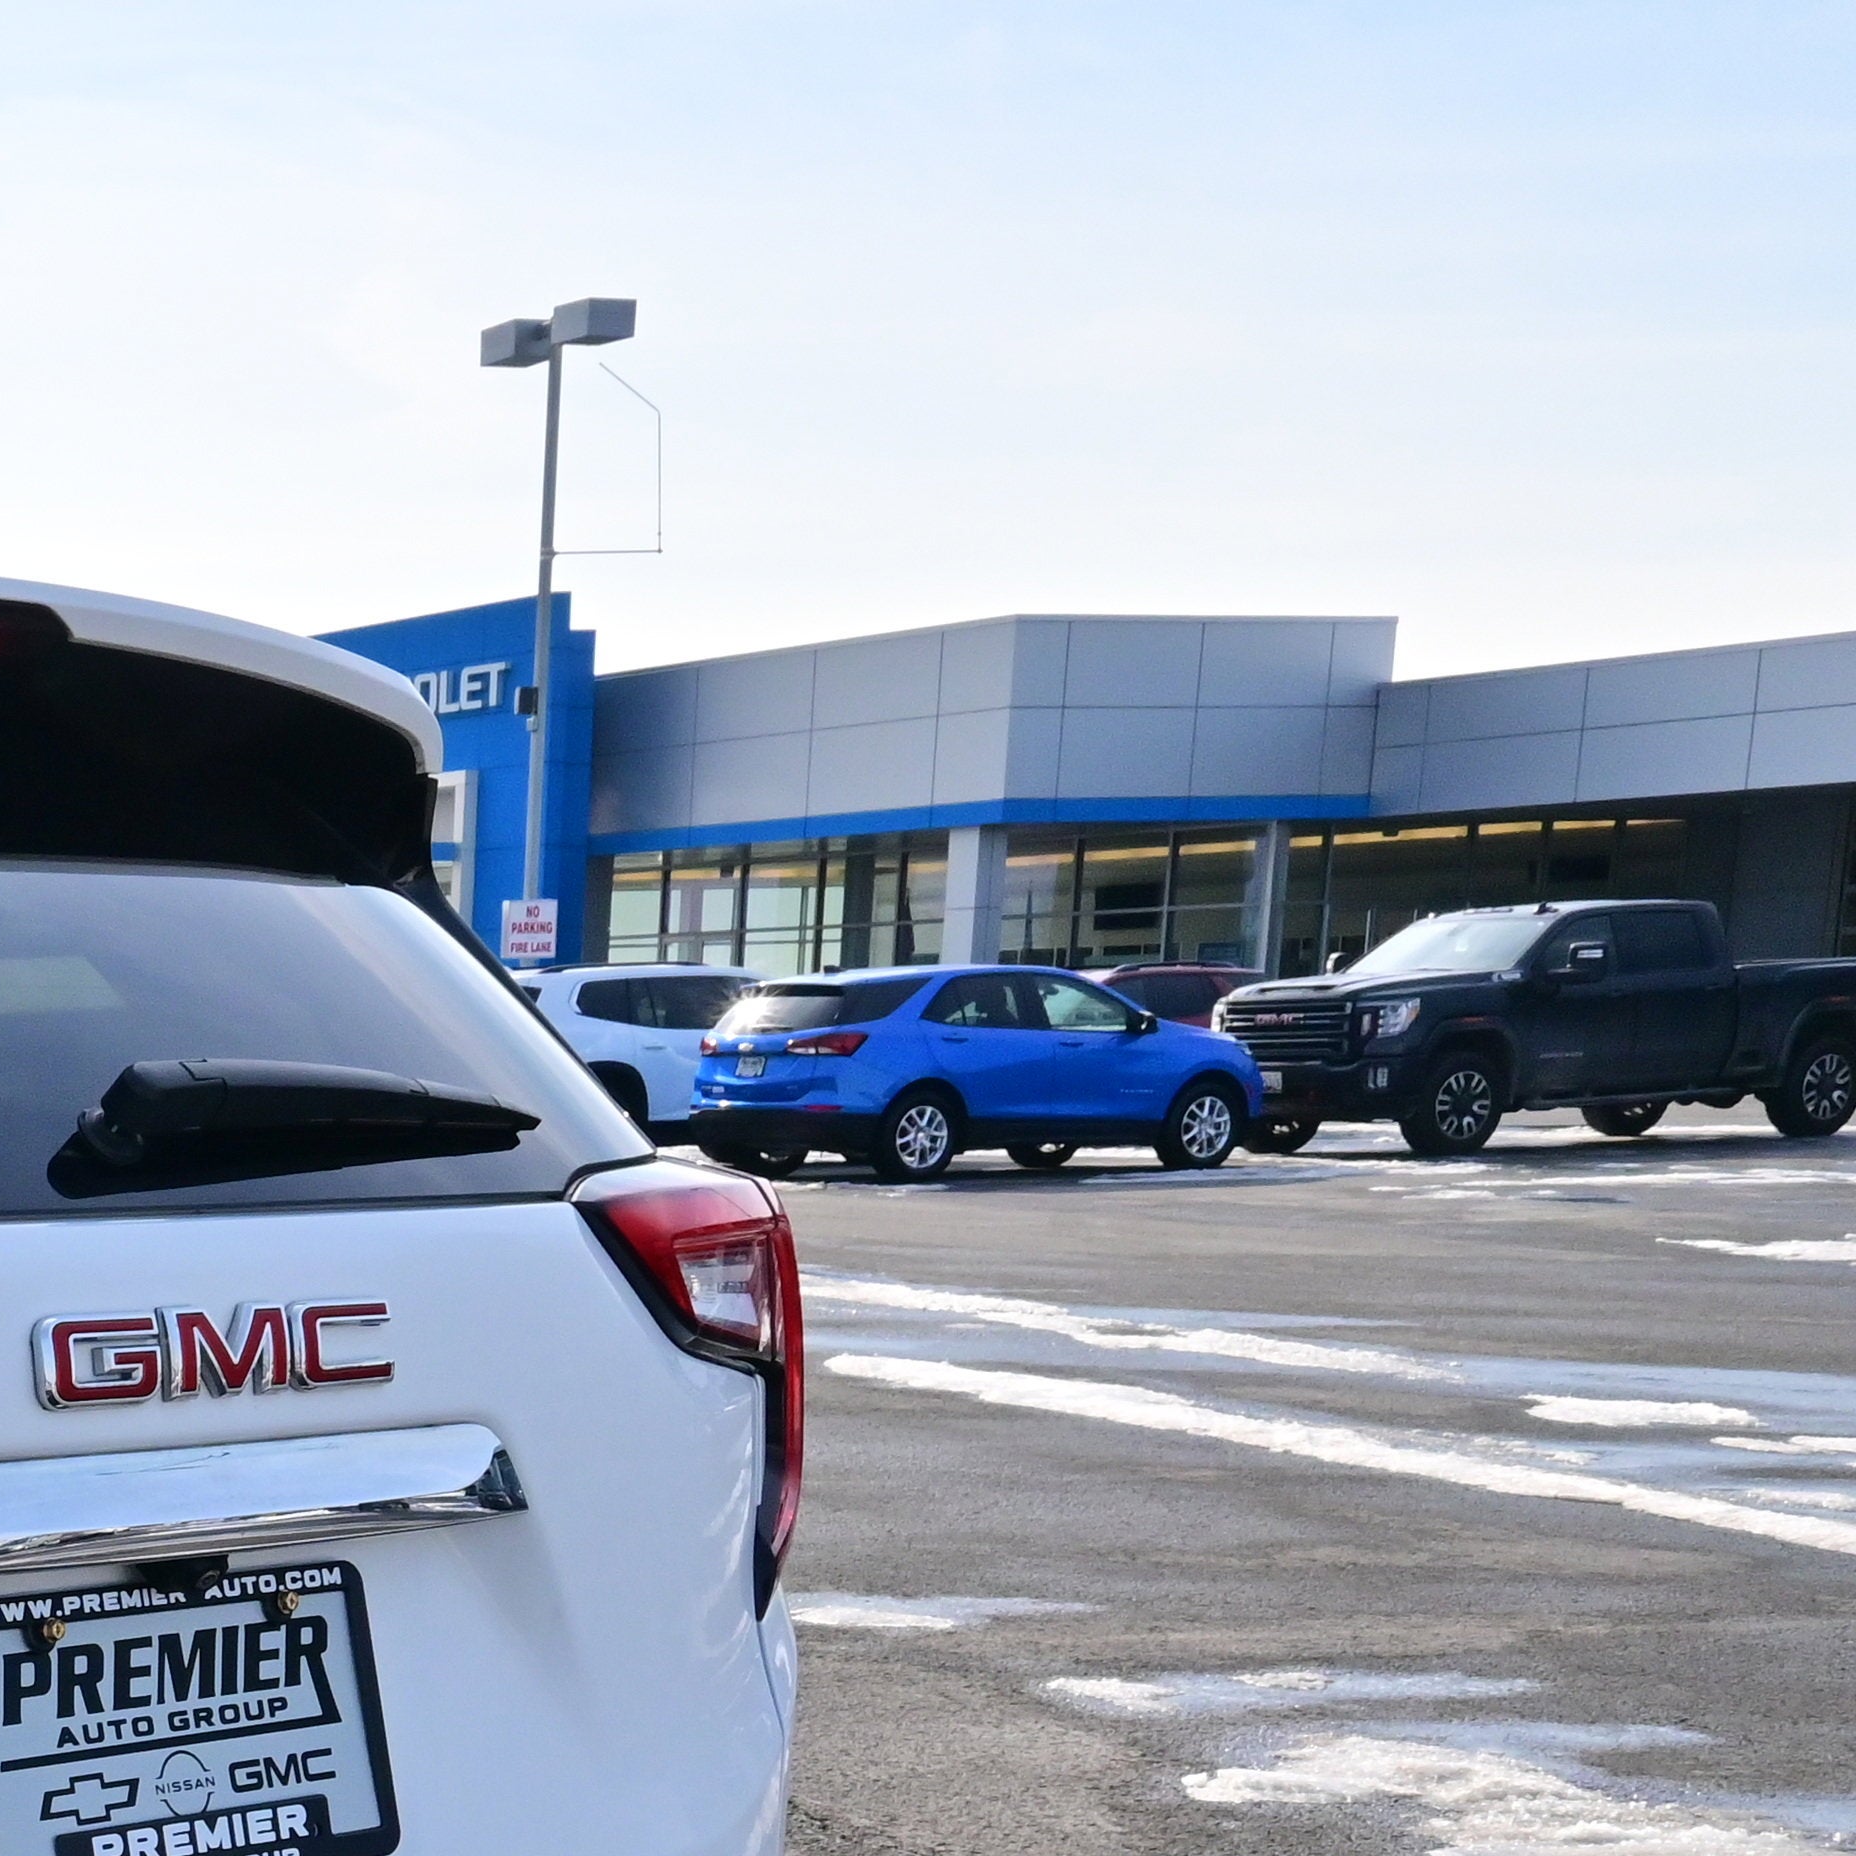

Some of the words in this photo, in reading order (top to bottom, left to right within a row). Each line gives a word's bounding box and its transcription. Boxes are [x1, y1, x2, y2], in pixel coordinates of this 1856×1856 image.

[412, 661, 508, 714] OLET
[511, 921, 553, 934] PARKING
[526, 905, 540, 918] NO
[510, 942, 528, 953] FIRE
[531, 942, 552, 953] LANE
[30, 1300, 396, 1411] GMC
[2, 1615, 330, 1727] PREMIER
[57, 1716, 155, 1748] AUTO
[168, 1696, 289, 1731] GROUP
[155, 1776, 216, 1795] NISSAN
[228, 1748, 336, 1793] GMC
